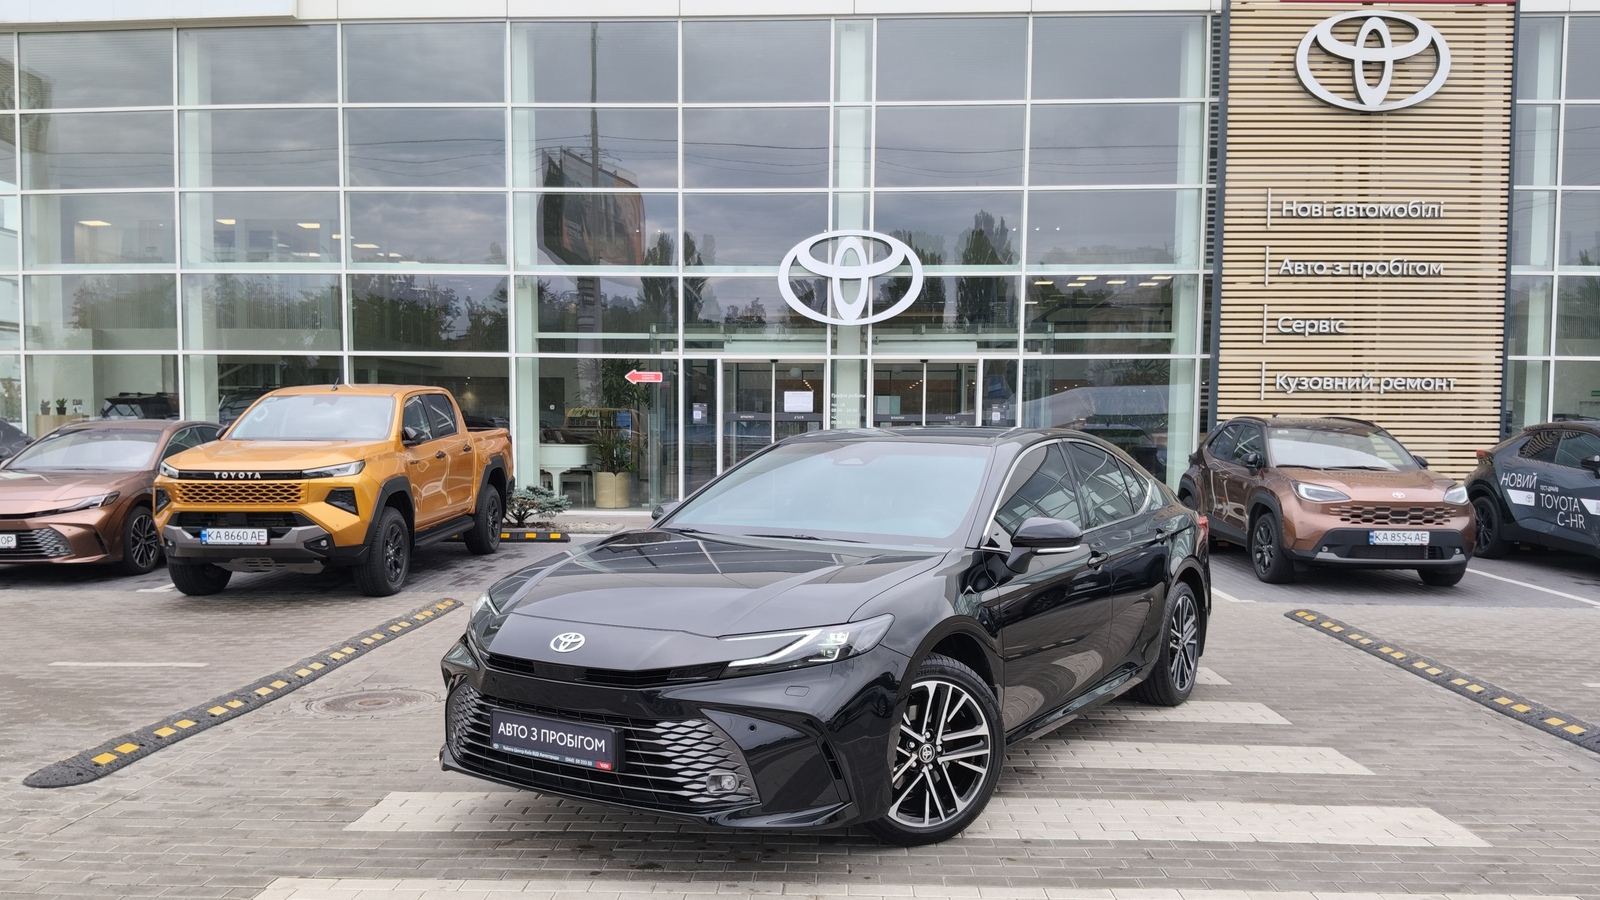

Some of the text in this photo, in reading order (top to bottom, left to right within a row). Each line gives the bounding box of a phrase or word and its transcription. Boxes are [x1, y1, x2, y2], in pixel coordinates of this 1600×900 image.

[1281, 200, 1444, 218] Нові автомобілі
[1279, 258, 1444, 279] Авто з пробігом
[1277, 316, 1346, 337] Сервіс
[1275, 372, 1457, 394] Кузовний ремонт
[213, 471, 262, 479] TOYOTA
[1500, 472, 1538, 489] НОВИЙ
[1540, 493, 1580, 513] TOYOTA
[1557, 511, 1586, 529] C-HR
[207, 530, 266, 541] KA 8660 AE
[1374, 532, 1428, 543] KA 8554 AE
[498, 722, 605, 753] АВТО З ПРОБІГОМ
